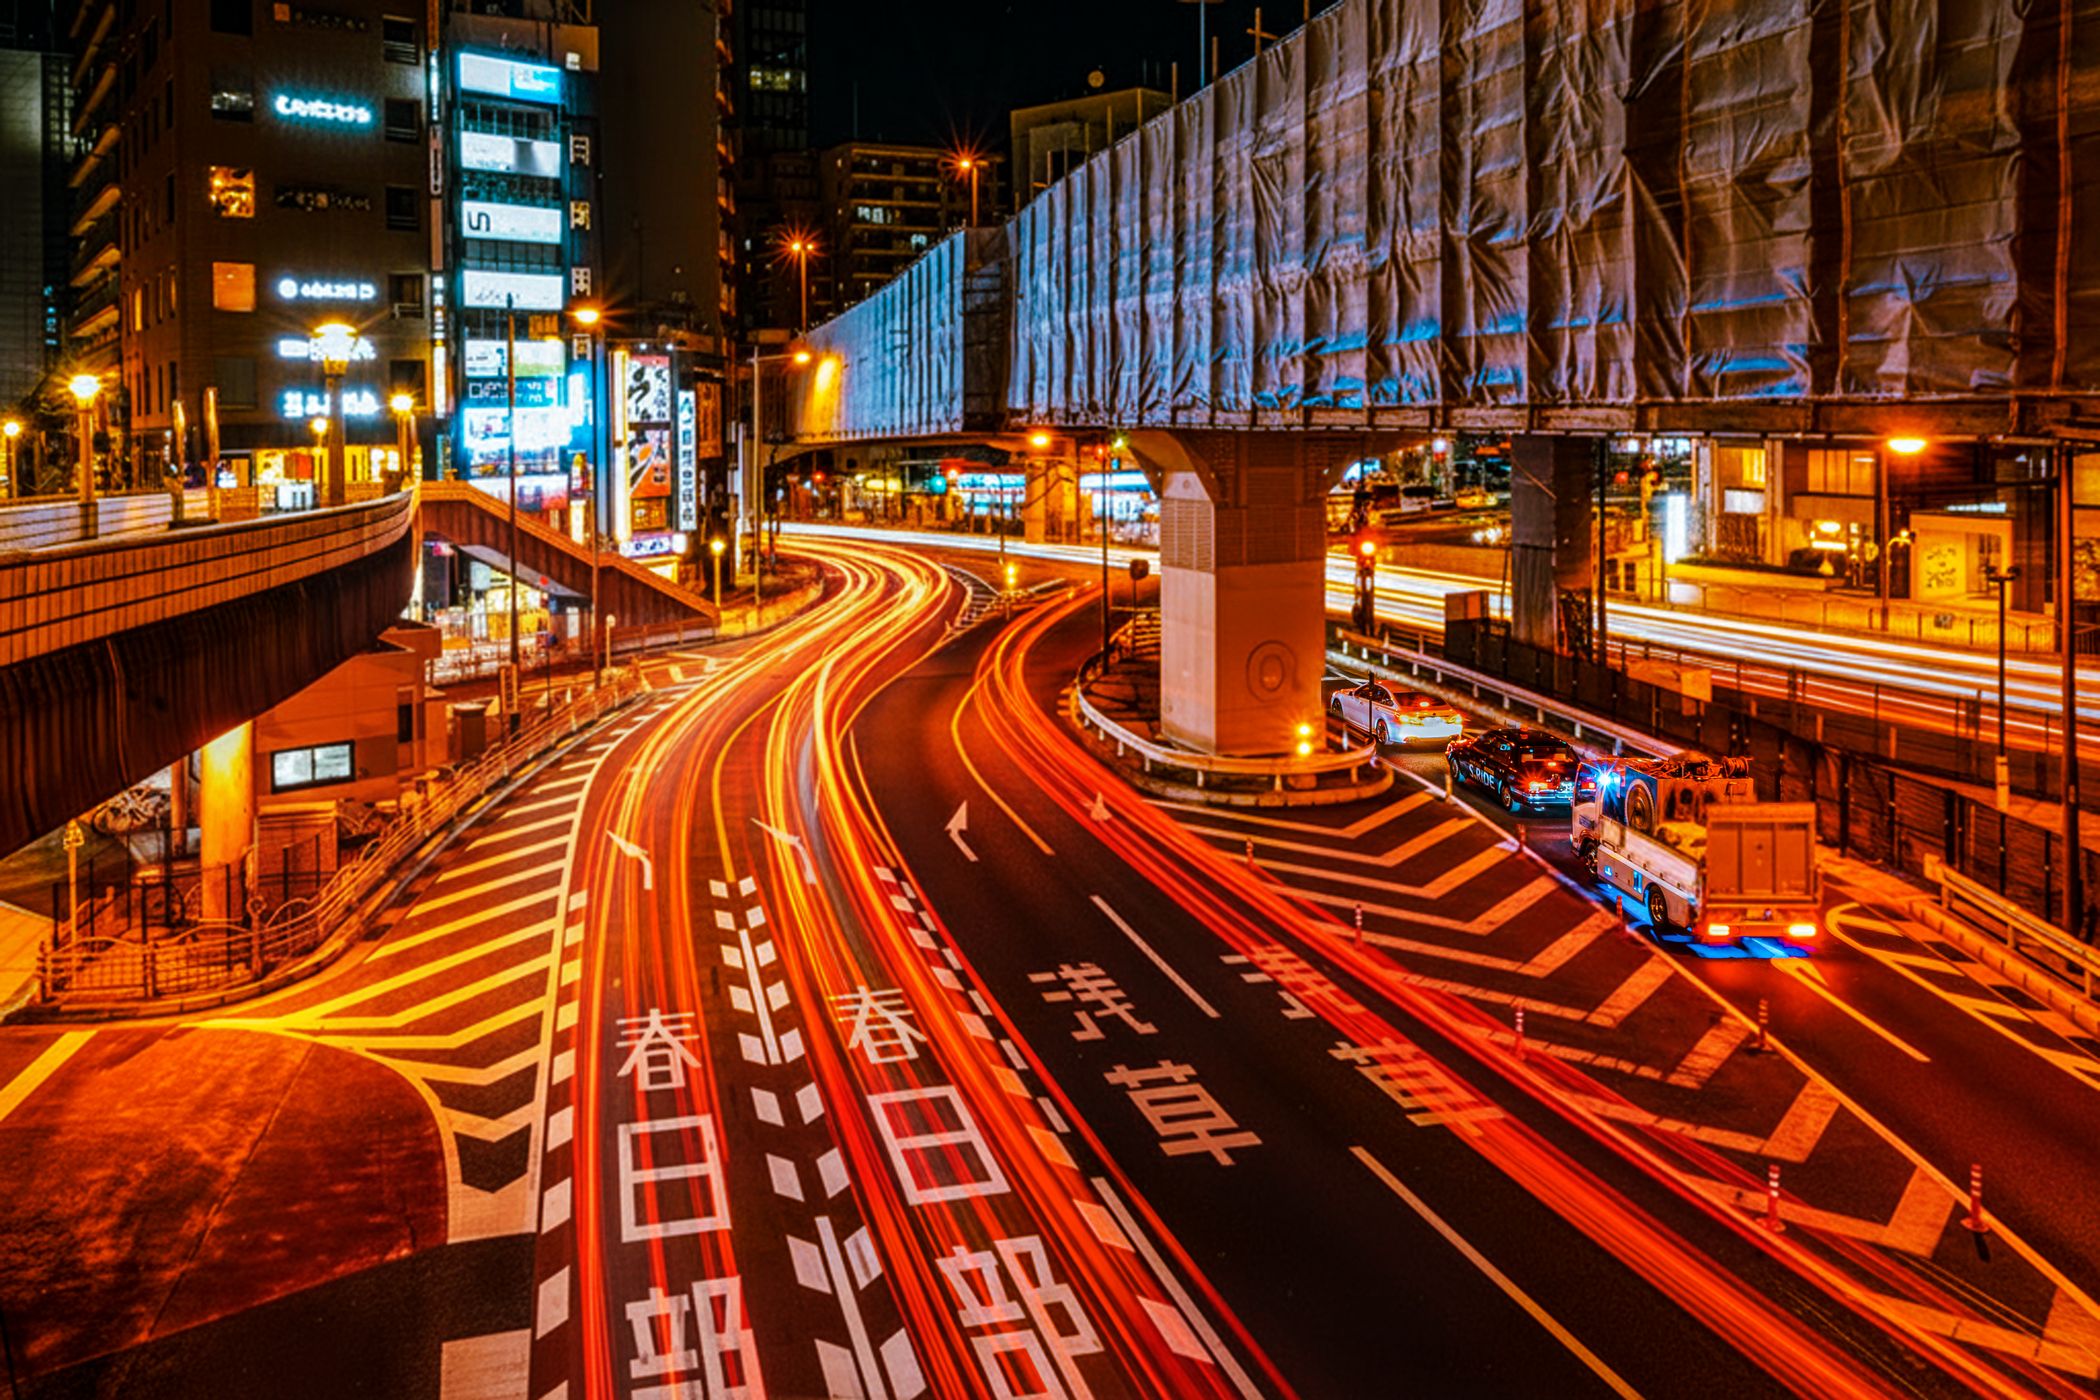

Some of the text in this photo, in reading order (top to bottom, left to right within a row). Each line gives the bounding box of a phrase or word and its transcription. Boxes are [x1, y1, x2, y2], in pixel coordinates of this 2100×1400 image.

[1469, 765, 1496, 788] S.RIDE
[1027, 961, 1262, 1167] 浅草
[1219, 943, 1506, 1137] 浅草
[615, 1008, 768, 1400] 春日部
[828, 985, 1105, 1400] 春日部
